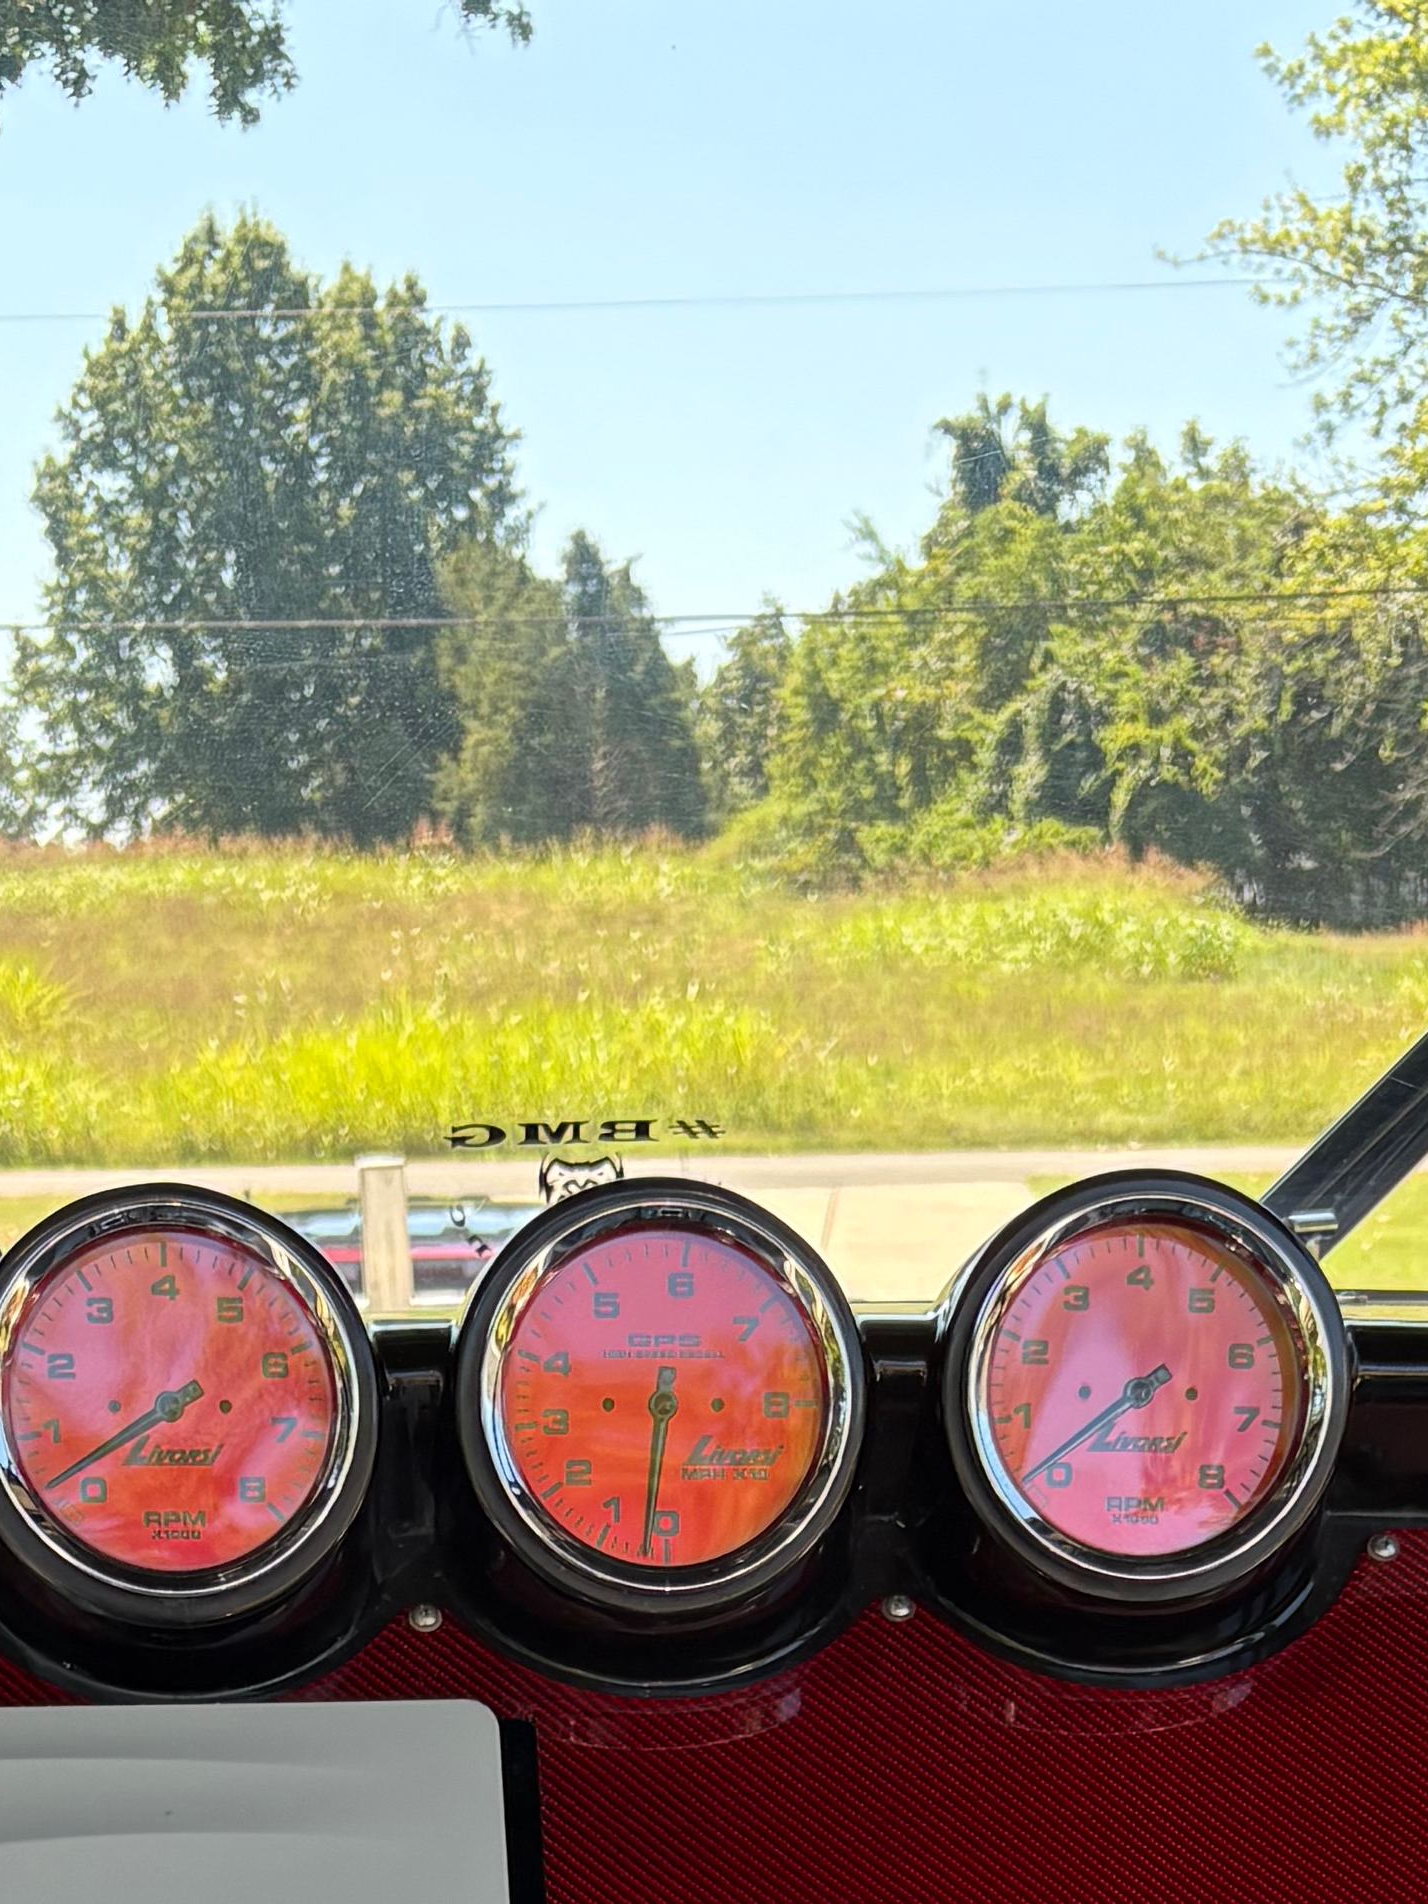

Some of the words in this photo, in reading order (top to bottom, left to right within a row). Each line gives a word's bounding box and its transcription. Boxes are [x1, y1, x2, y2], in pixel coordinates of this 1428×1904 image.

[151, 1275, 179, 1301] 4
[668, 1272, 694, 1297] 6
[1126, 1265, 1154, 1291] 4
[86, 1298, 113, 1324] 3
[217, 1297, 243, 1323] 5
[593, 1293, 620, 1319] 5
[1062, 1286, 1089, 1311] 3
[1188, 1288, 1215, 1313] 5
[628, 1334, 701, 1347] GPS
[733, 1317, 759, 1342] 7
[542, 1353, 571, 1376] 4
[1021, 1340, 1049, 1365] 2
[1227, 1343, 1254, 1369] 6
[47, 1354, 76, 1379] 2
[261, 1352, 288, 1379] 6
[763, 1392, 789, 1418] 8
[1013, 1403, 1030, 1428] 1
[43, 1420, 60, 1444] 1
[271, 1417, 297, 1442] 7
[542, 1409, 569, 1435] 3
[1233, 1407, 1260, 1432] 7
[564, 1460, 592, 1486] 2
[1045, 1462, 1072, 1488] 0
[1198, 1464, 1225, 1489] 8
[80, 1478, 107, 1503] 0
[239, 1476, 265, 1502] 8
[602, 1496, 620, 1523] 1
[1106, 1497, 1164, 1511] RPM
[143, 1511, 205, 1528] RPM
[653, 1510, 679, 1537] 0
